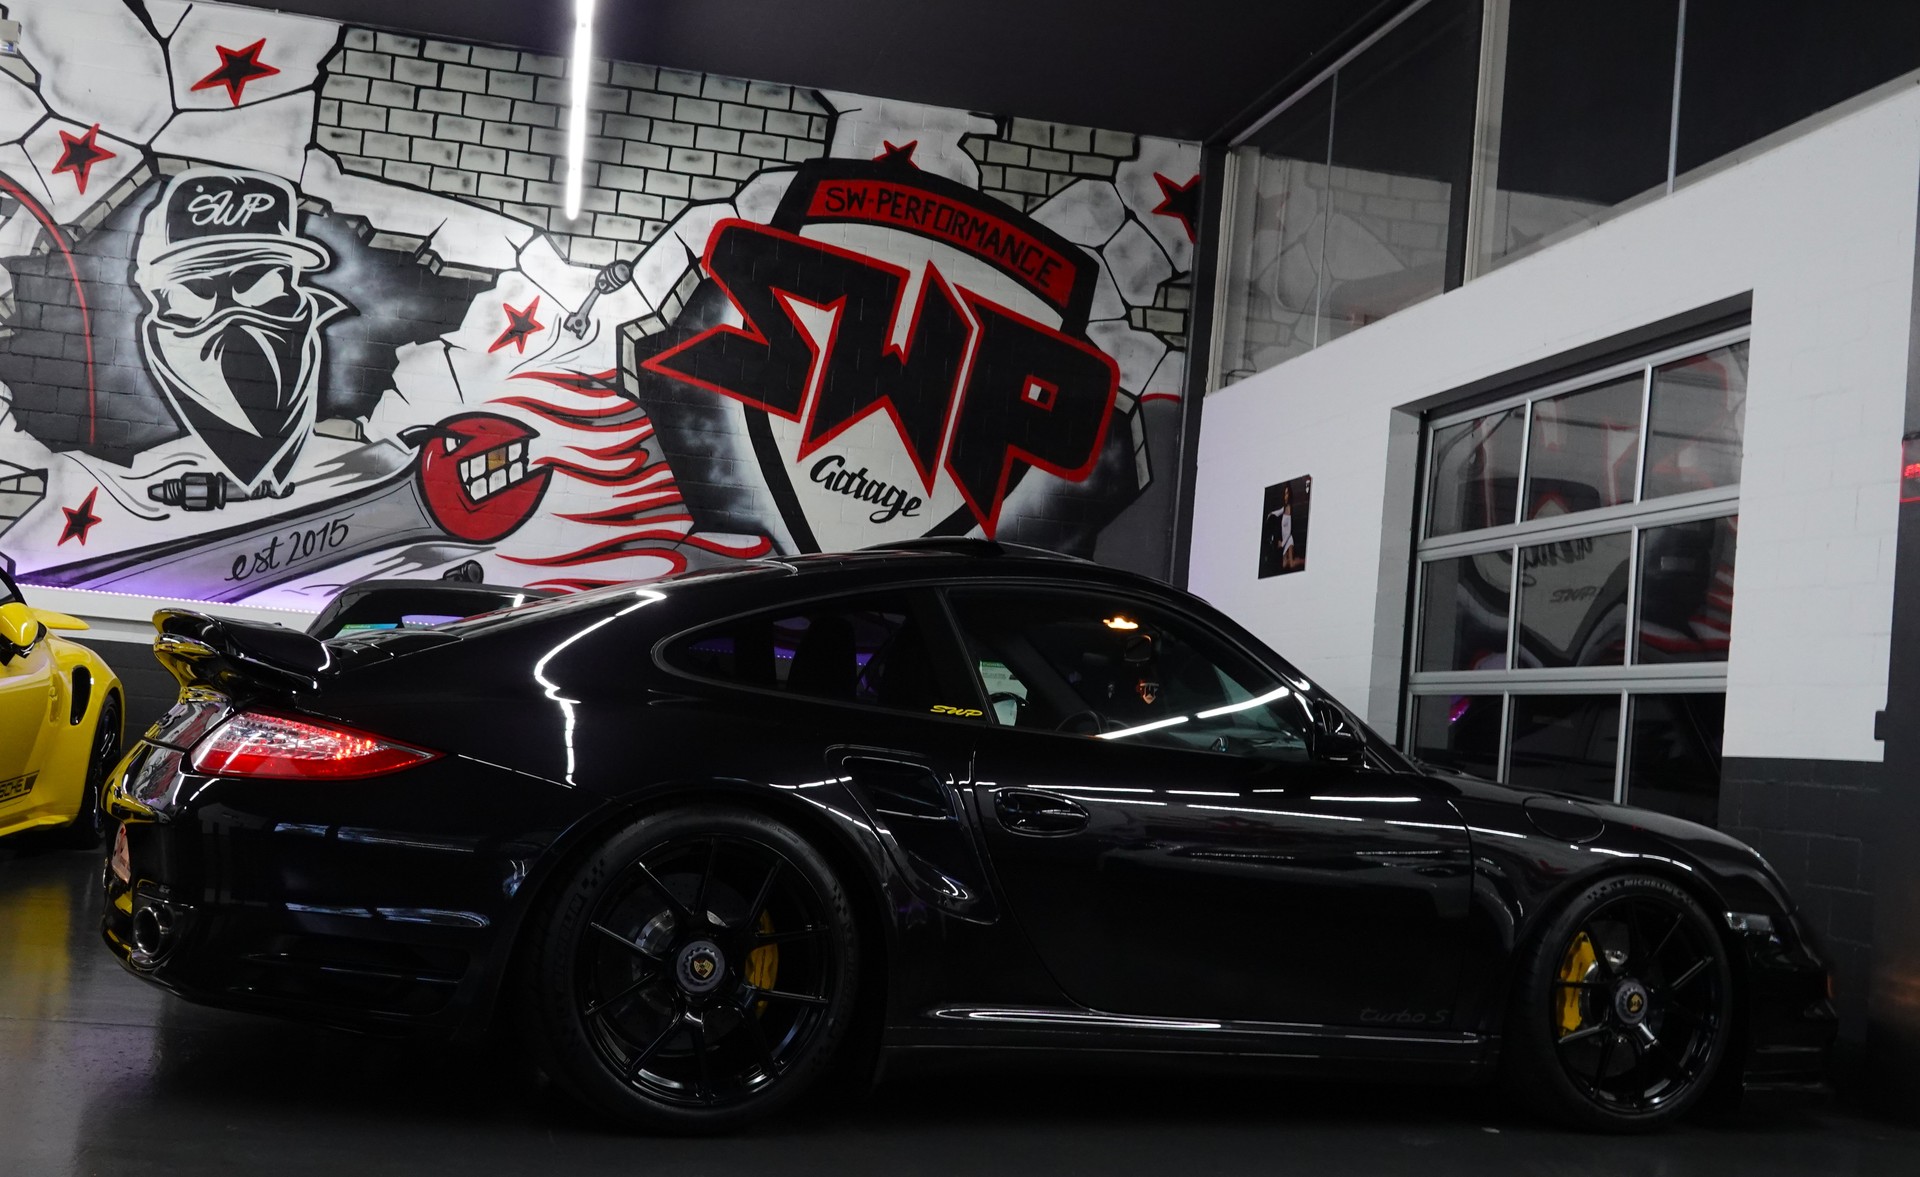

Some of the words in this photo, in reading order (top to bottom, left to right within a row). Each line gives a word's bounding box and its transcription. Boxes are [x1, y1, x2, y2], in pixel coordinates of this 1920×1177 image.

[187, 189, 276, 227] SWP
[825, 187, 1062, 289] SW-PERFORMANCE
[641, 217, 1120, 539] SWP
[810, 454, 922, 524] Garage
[224, 536, 284, 581] est
[285, 513, 355, 566] 2015
[930, 704, 983, 717] SWP
[1360, 1007, 1426, 1023] turbo
[1428, 1008, 1449, 1024] S
